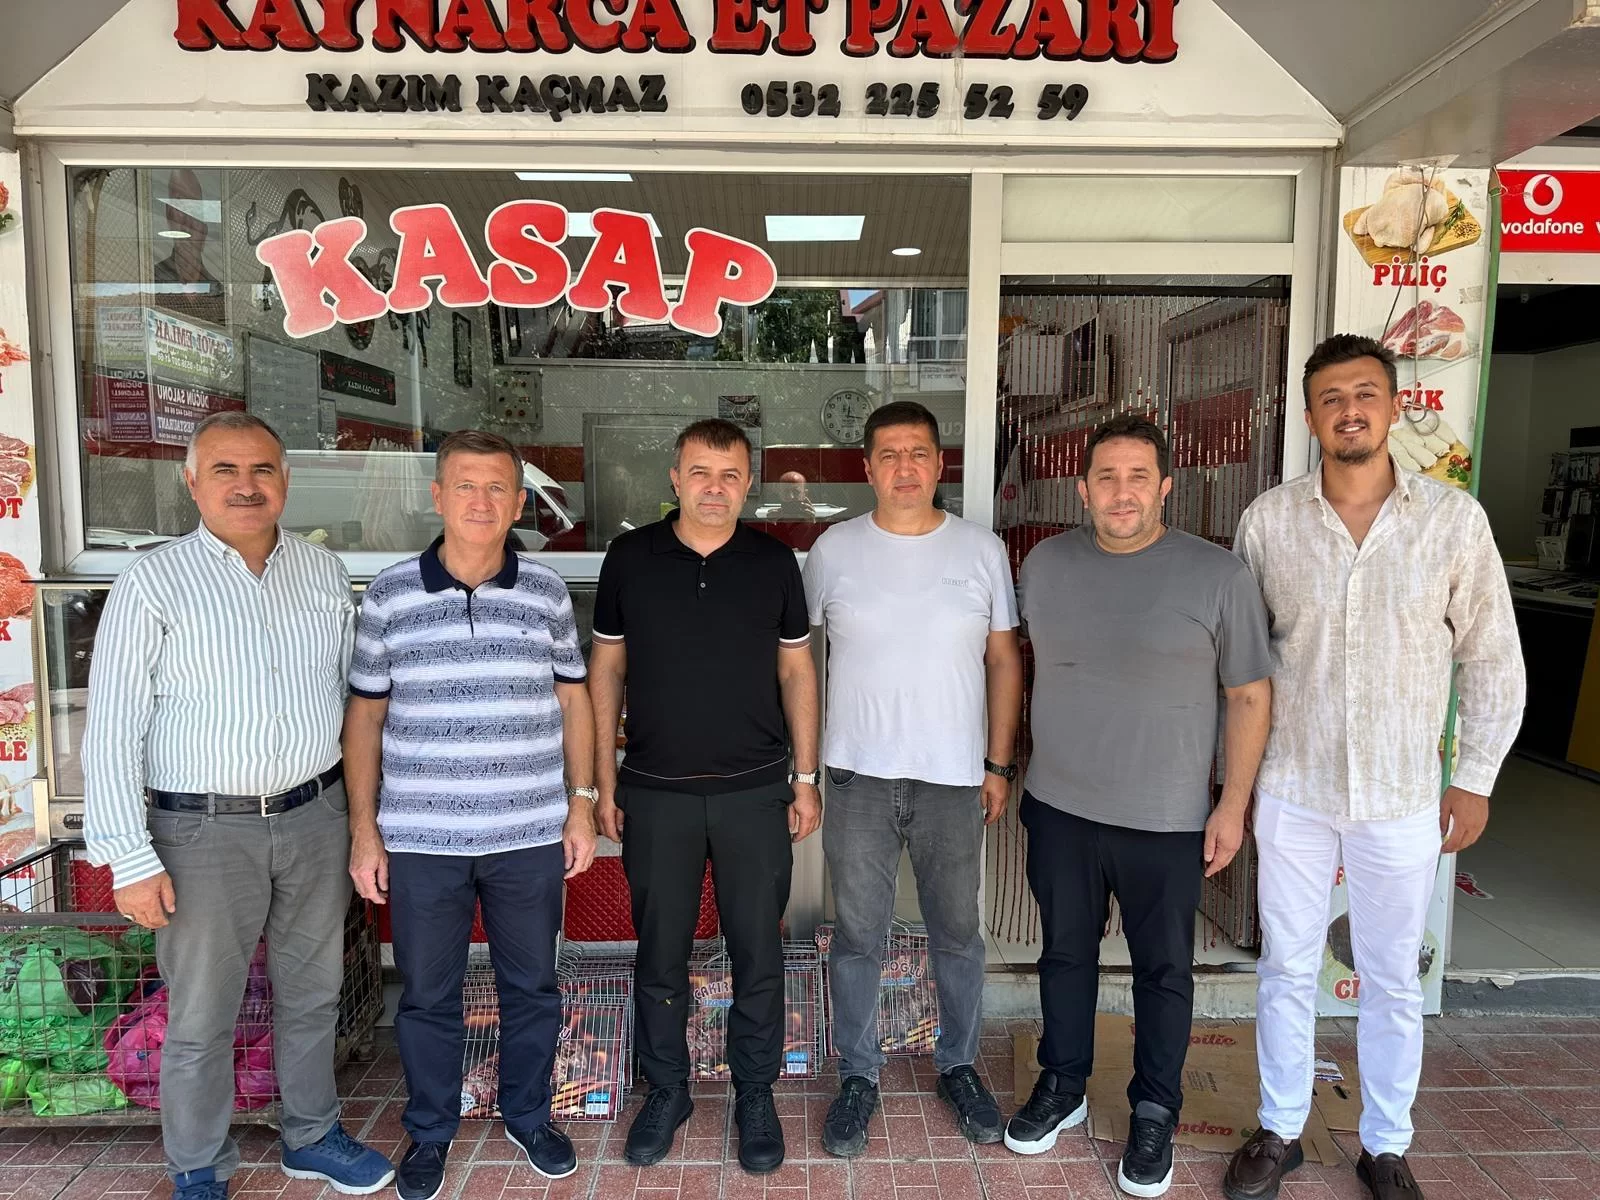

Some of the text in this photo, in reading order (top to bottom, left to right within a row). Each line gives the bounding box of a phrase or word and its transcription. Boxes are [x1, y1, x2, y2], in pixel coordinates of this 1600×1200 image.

[174, 0, 1179, 64] KAYNARCA ET PAZARI
[305, 73, 1089, 122] KAZIM KAÇMAZ 0532 225 52 59
[1500, 218, 1584, 235] vodafone
[256, 199, 778, 339] KASAP
[1373, 256, 1447, 293] PİLİÇ
[1400, 381, 1444, 411] CİK
[880, 958, 924, 978] ROĞLU
[1335, 971, 1360, 999] Cİ
